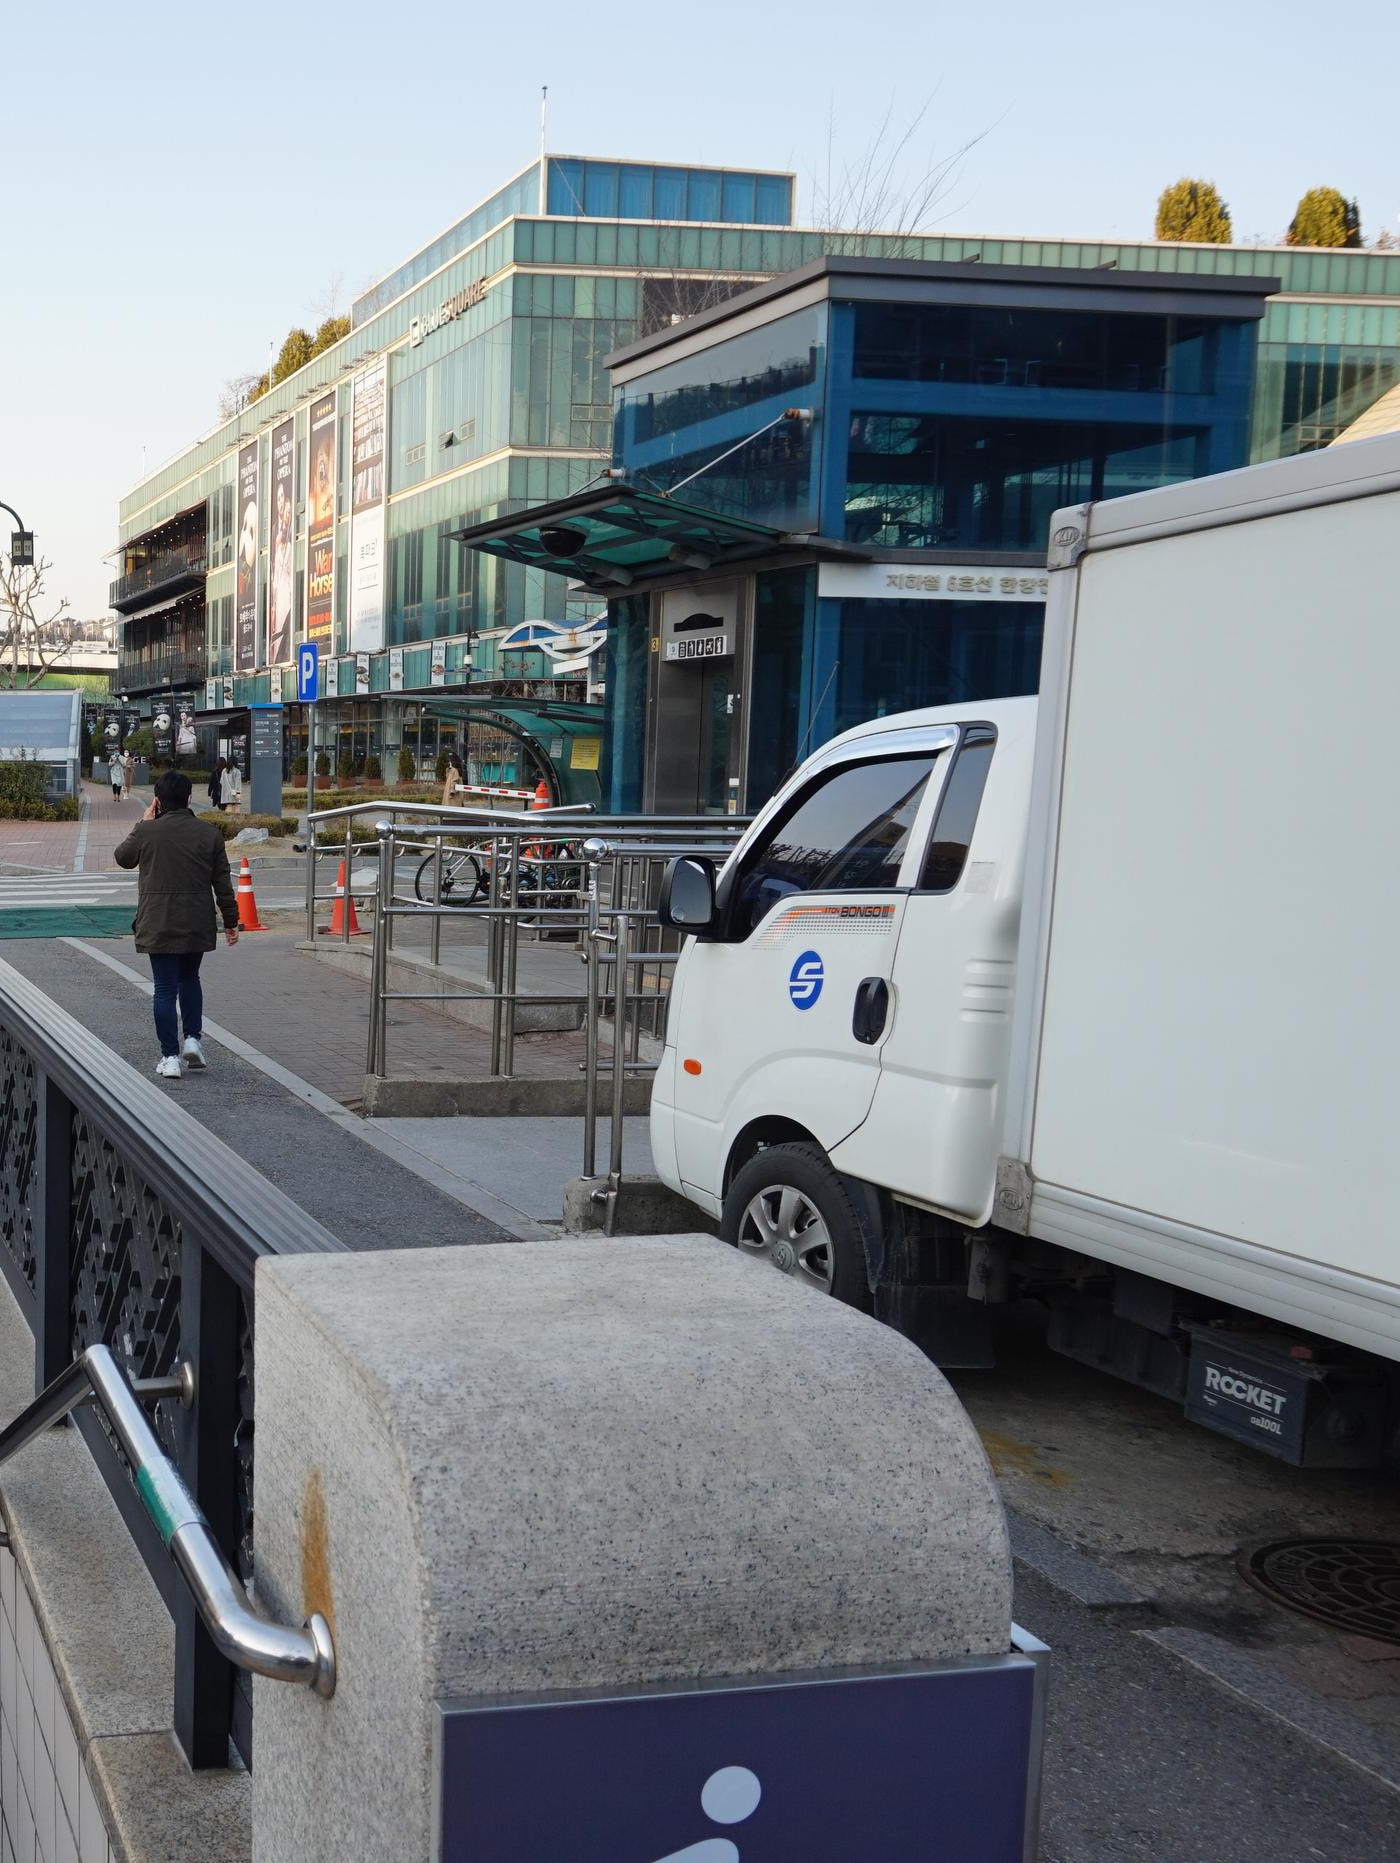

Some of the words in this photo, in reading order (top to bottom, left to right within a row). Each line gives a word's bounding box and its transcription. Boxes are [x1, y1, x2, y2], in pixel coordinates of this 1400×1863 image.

[314, 549, 332, 575] War
[309, 572, 332, 598] Horse
[886, 573, 941, 591] 지하철
[947, 575, 993, 593] 6호선
[652, 639, 658, 651] 3
[301, 652, 314, 694] P
[840, 906, 882, 918] BONGO
[1204, 1366, 1288, 1415] ROCKET
